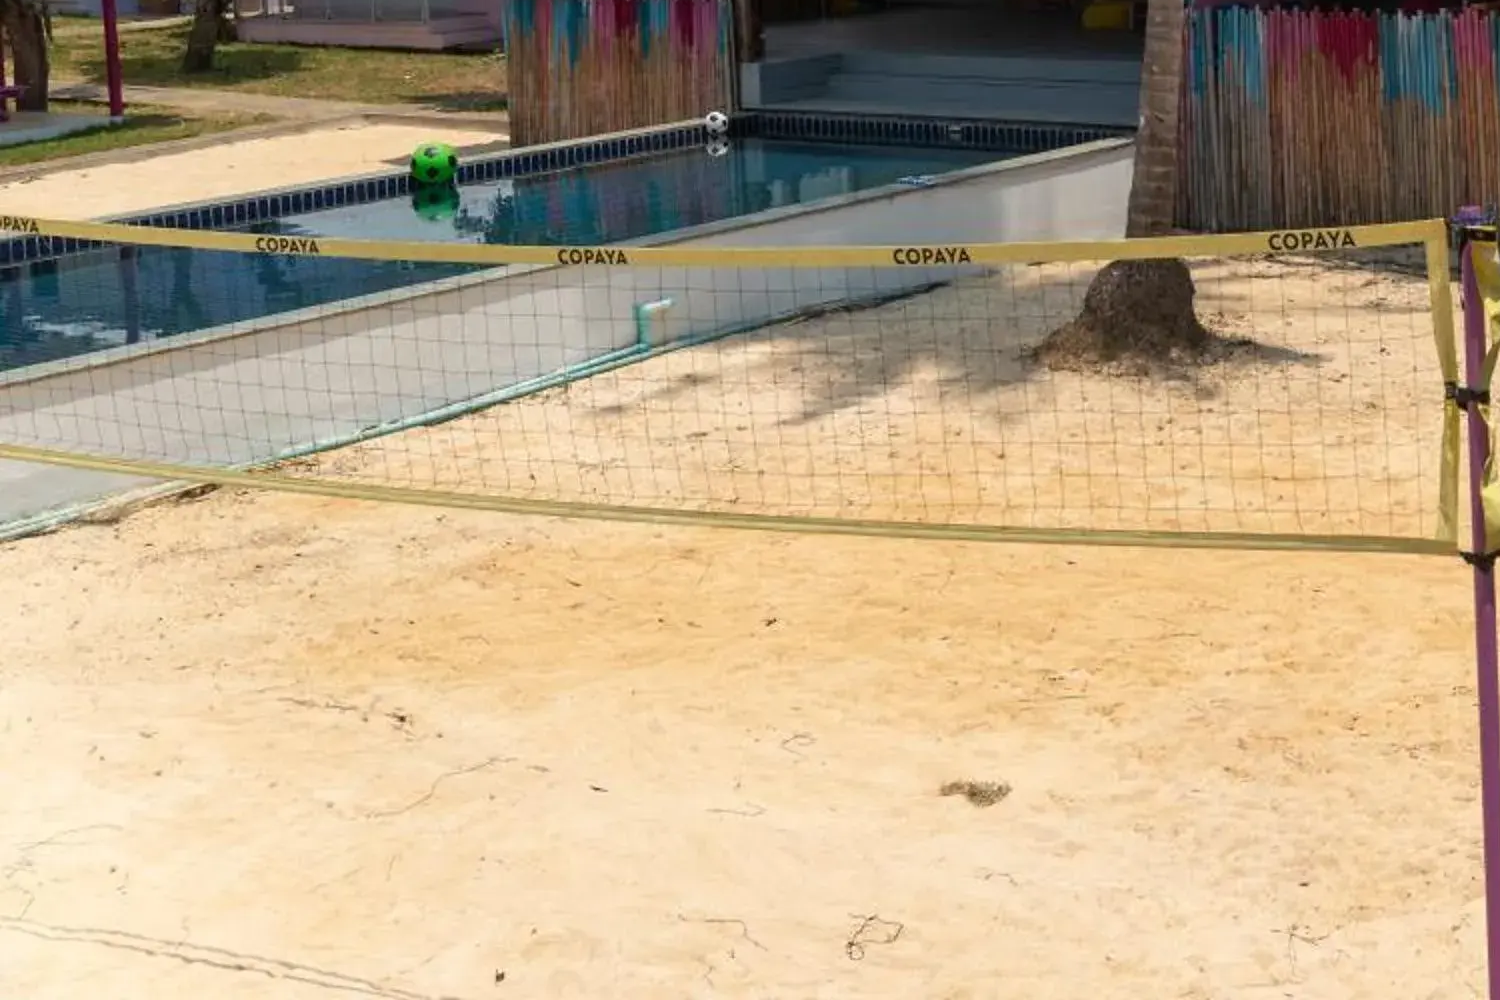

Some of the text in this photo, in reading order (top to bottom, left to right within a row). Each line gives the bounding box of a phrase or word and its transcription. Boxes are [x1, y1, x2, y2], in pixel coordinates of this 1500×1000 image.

[0, 215, 39, 233] PAYA
[255, 237, 319, 253] COPAYA
[1268, 230, 1355, 251] COPAYA
[557, 248, 627, 265] COPAYA
[893, 247, 971, 265] COPAYA
